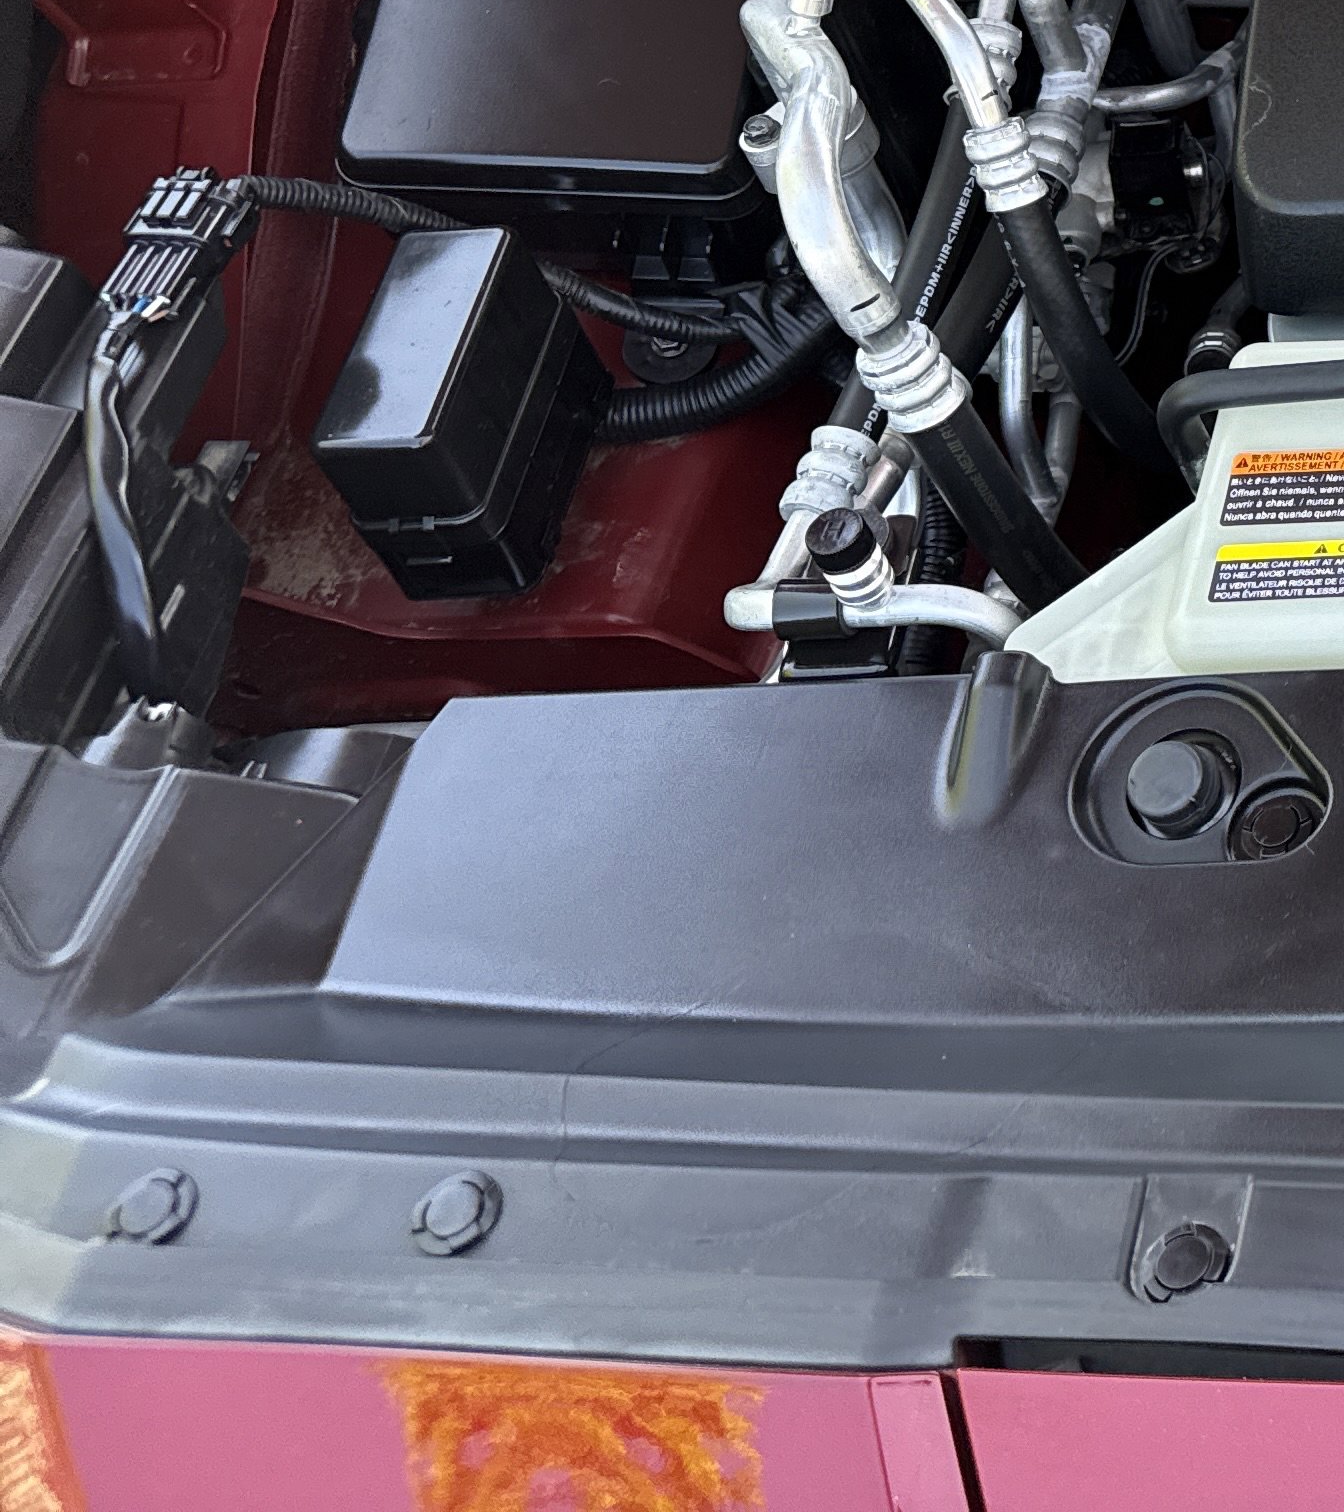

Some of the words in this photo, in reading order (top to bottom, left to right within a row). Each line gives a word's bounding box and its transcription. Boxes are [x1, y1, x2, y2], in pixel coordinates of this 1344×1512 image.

[1280, 452, 1333, 461] WARNING
[1249, 462, 1338, 473] AVERTISSEMENT
[1262, 487, 1276, 496] Sie
[1306, 498, 1335, 506] nunca
[1224, 511, 1253, 521] Nunca
[1255, 510, 1276, 520] abra
[1278, 509, 1312, 521] quando
[1220, 563, 1238, 571] FAN
[1240, 561, 1269, 570] BLADE
[1271, 560, 1291, 568] CAN
[1292, 559, 1320, 567] START
[1219, 572, 1230, 580] TO
[1233, 571, 1256, 579] HELP
[1257, 569, 1285, 578] AVOID
[1287, 568, 1335, 576] PERSONAL
[1229, 580, 1287, 590] VENTILATEUR
[1289, 578, 1322, 587] RISQUE
[1325, 577, 1337, 585] DE
[1214, 591, 1241, 599] POUR
[1274, 589, 1303, 597] TOUTE
